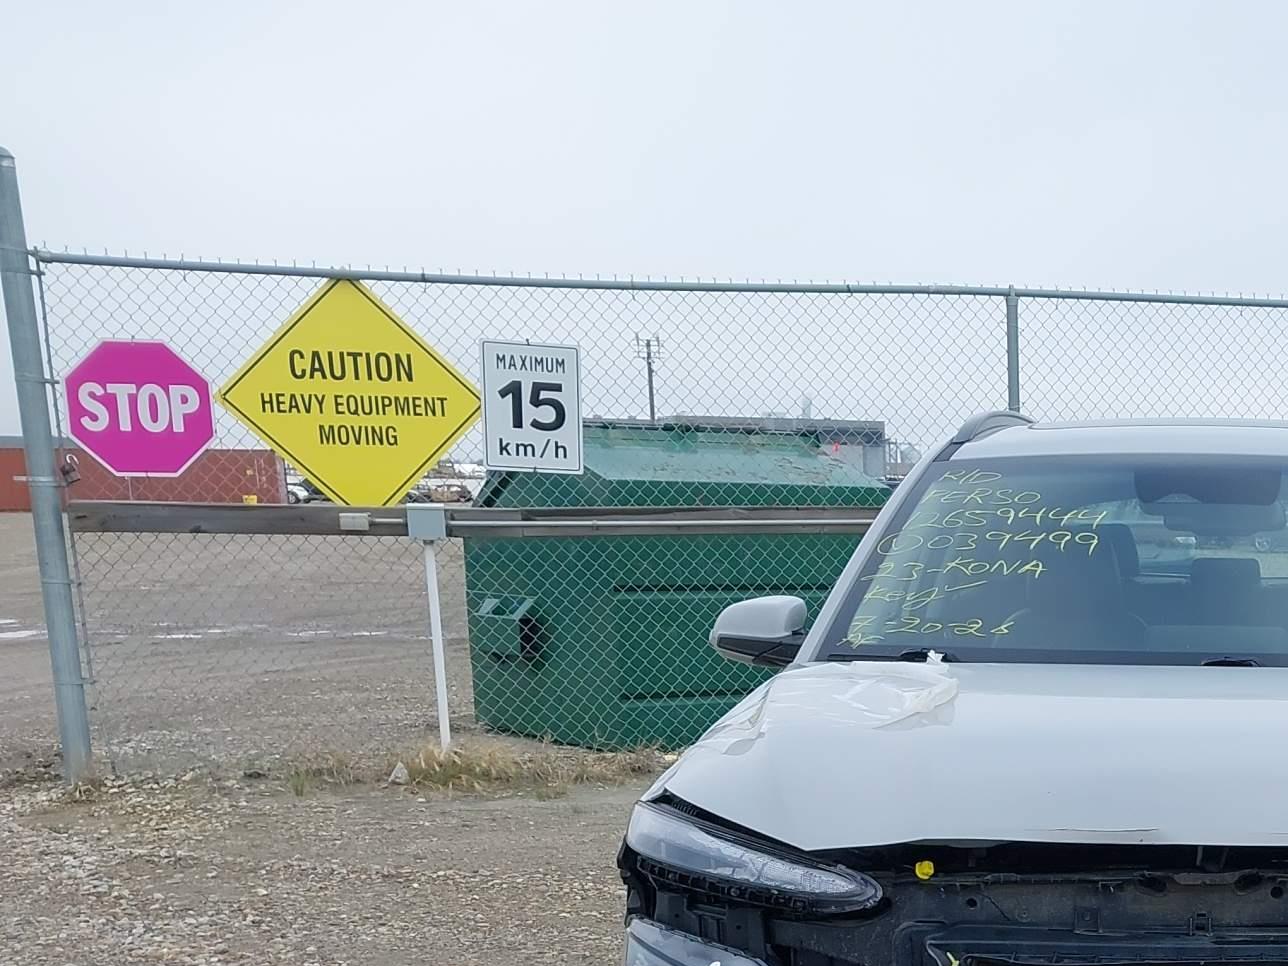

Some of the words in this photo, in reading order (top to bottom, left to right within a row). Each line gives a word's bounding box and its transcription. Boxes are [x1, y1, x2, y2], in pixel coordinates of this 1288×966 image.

[288, 349, 414, 383] CAUTION
[495, 353, 566, 375] MAXIMUM
[77, 382, 200, 434] STOP
[260, 392, 326, 415] HEAVY
[333, 394, 448, 418] EQUIPMENT
[497, 380, 566, 432] 15
[318, 424, 399, 447] MOVING
[498, 437, 568, 460] km/h
[901, 507, 1107, 530] 12659444
